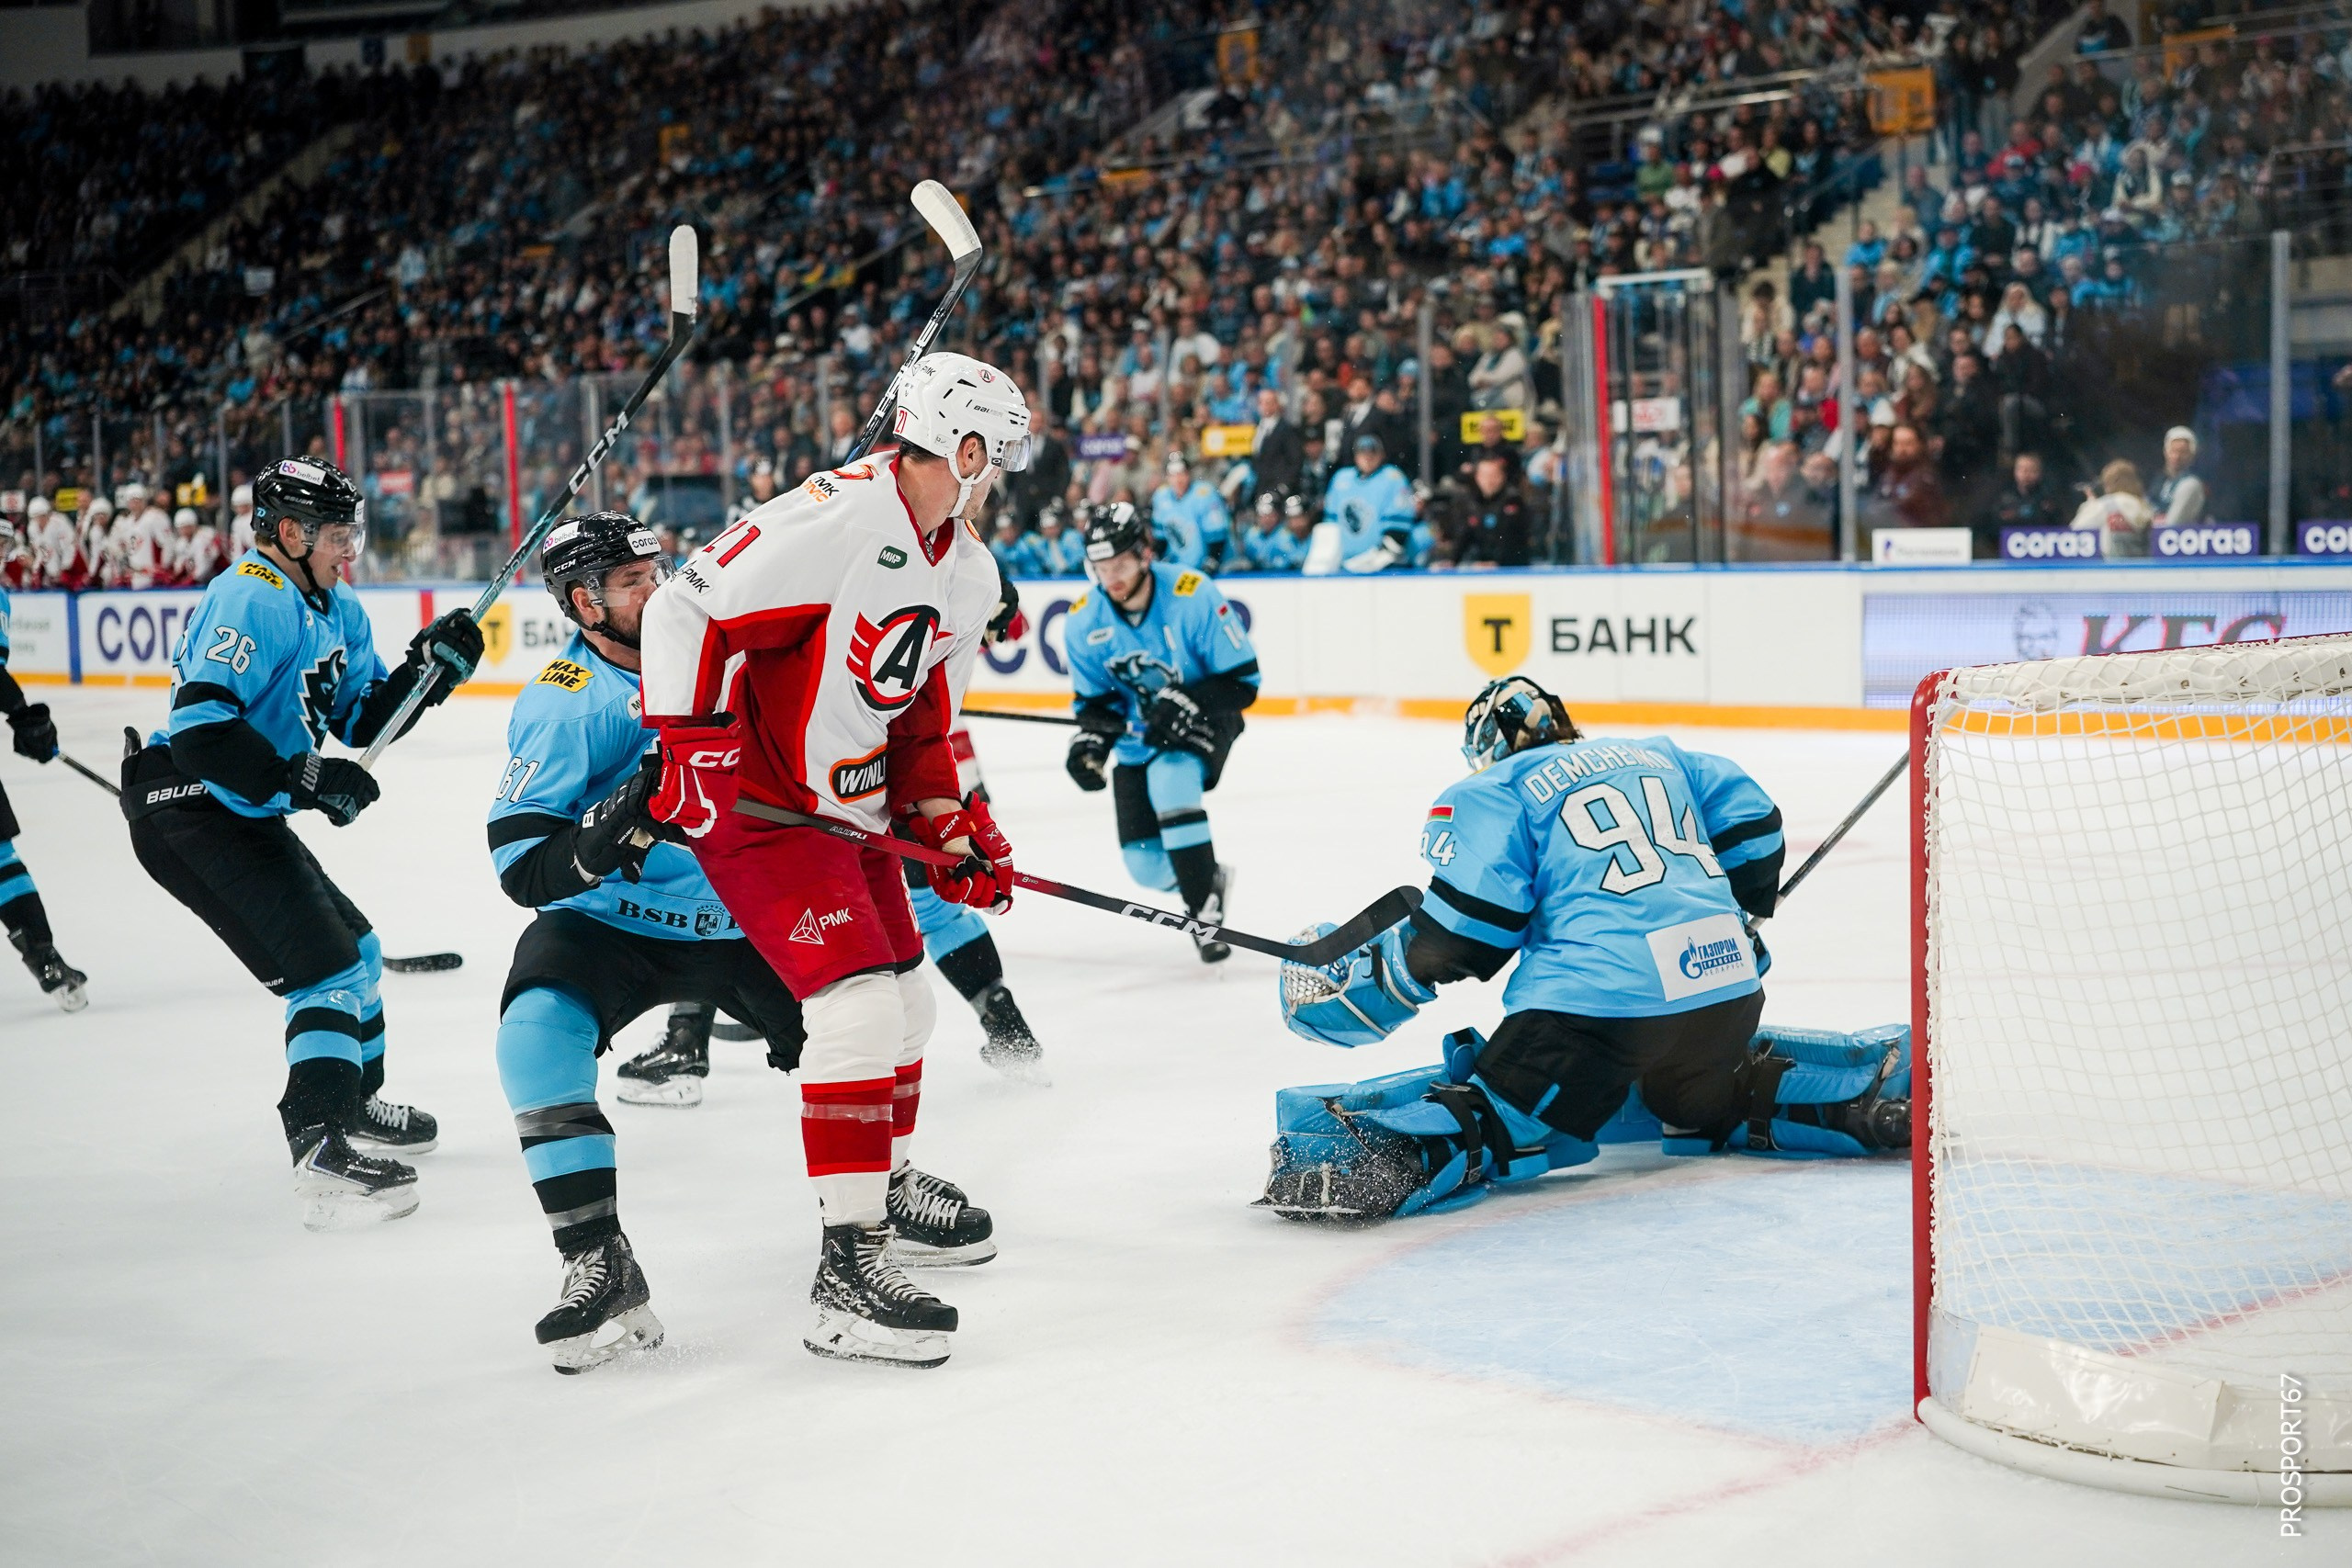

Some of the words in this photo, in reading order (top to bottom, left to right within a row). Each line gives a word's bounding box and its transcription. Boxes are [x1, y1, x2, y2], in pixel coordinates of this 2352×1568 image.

[895, 410, 908, 434] 21
[569, 412, 629, 494] CCM
[244, 569, 278, 586] LINE
[245, 563, 280, 580] MAX
[553, 558, 576, 573] CCM
[1484, 618, 1512, 653] Т
[1551, 617, 1696, 654] БАНК
[205, 625, 257, 676] 26
[540, 671, 581, 689] LINE
[547, 660, 586, 677] MAX
[688, 747, 741, 768] CC
[495, 756, 540, 804] 61
[840, 756, 886, 795] WINL
[939, 814, 960, 839] CCM
[1559, 775, 1726, 897] 94
[614, 897, 688, 929] BSB
[1119, 903, 1222, 941] CCM
[1697, 937, 1739, 961] ГАЗПРОМ
[1702, 952, 1742, 970] ТРАНСГАЗ
[1703, 962, 1745, 976] БЕЛАРУСЬ
